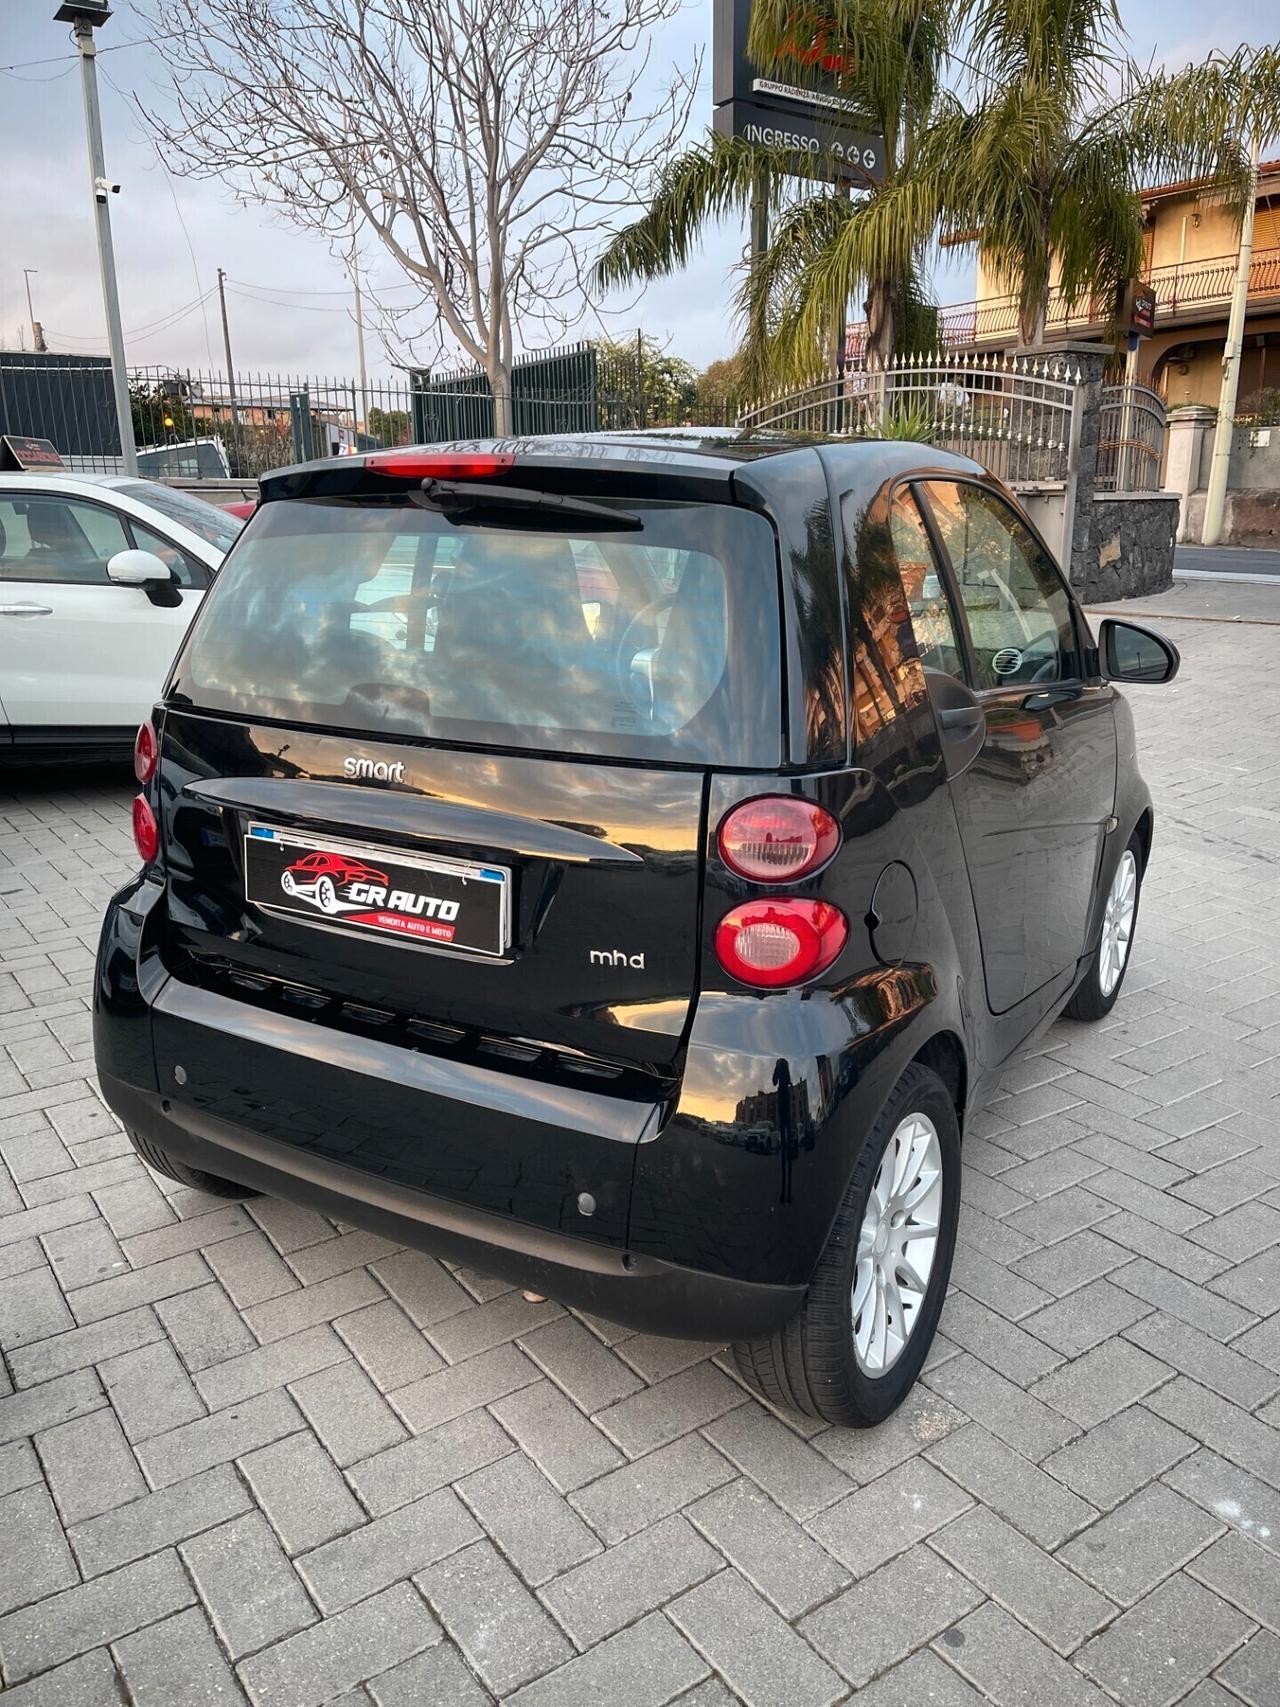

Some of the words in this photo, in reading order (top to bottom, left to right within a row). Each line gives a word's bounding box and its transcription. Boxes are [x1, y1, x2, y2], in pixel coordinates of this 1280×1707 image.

[759, 80, 783, 93] GRUPPO
[747, 123, 820, 154] INGRESSO
[344, 757, 405, 783] smart
[347, 882, 388, 907] GR
[387, 890, 460, 921] AUTO
[377, 914, 405, 929] VENDITA
[407, 920, 425, 933] AUTO
[425, 925, 431, 934] E
[431, 926, 452, 938] MOTO
[589, 949, 645, 969] mhd
